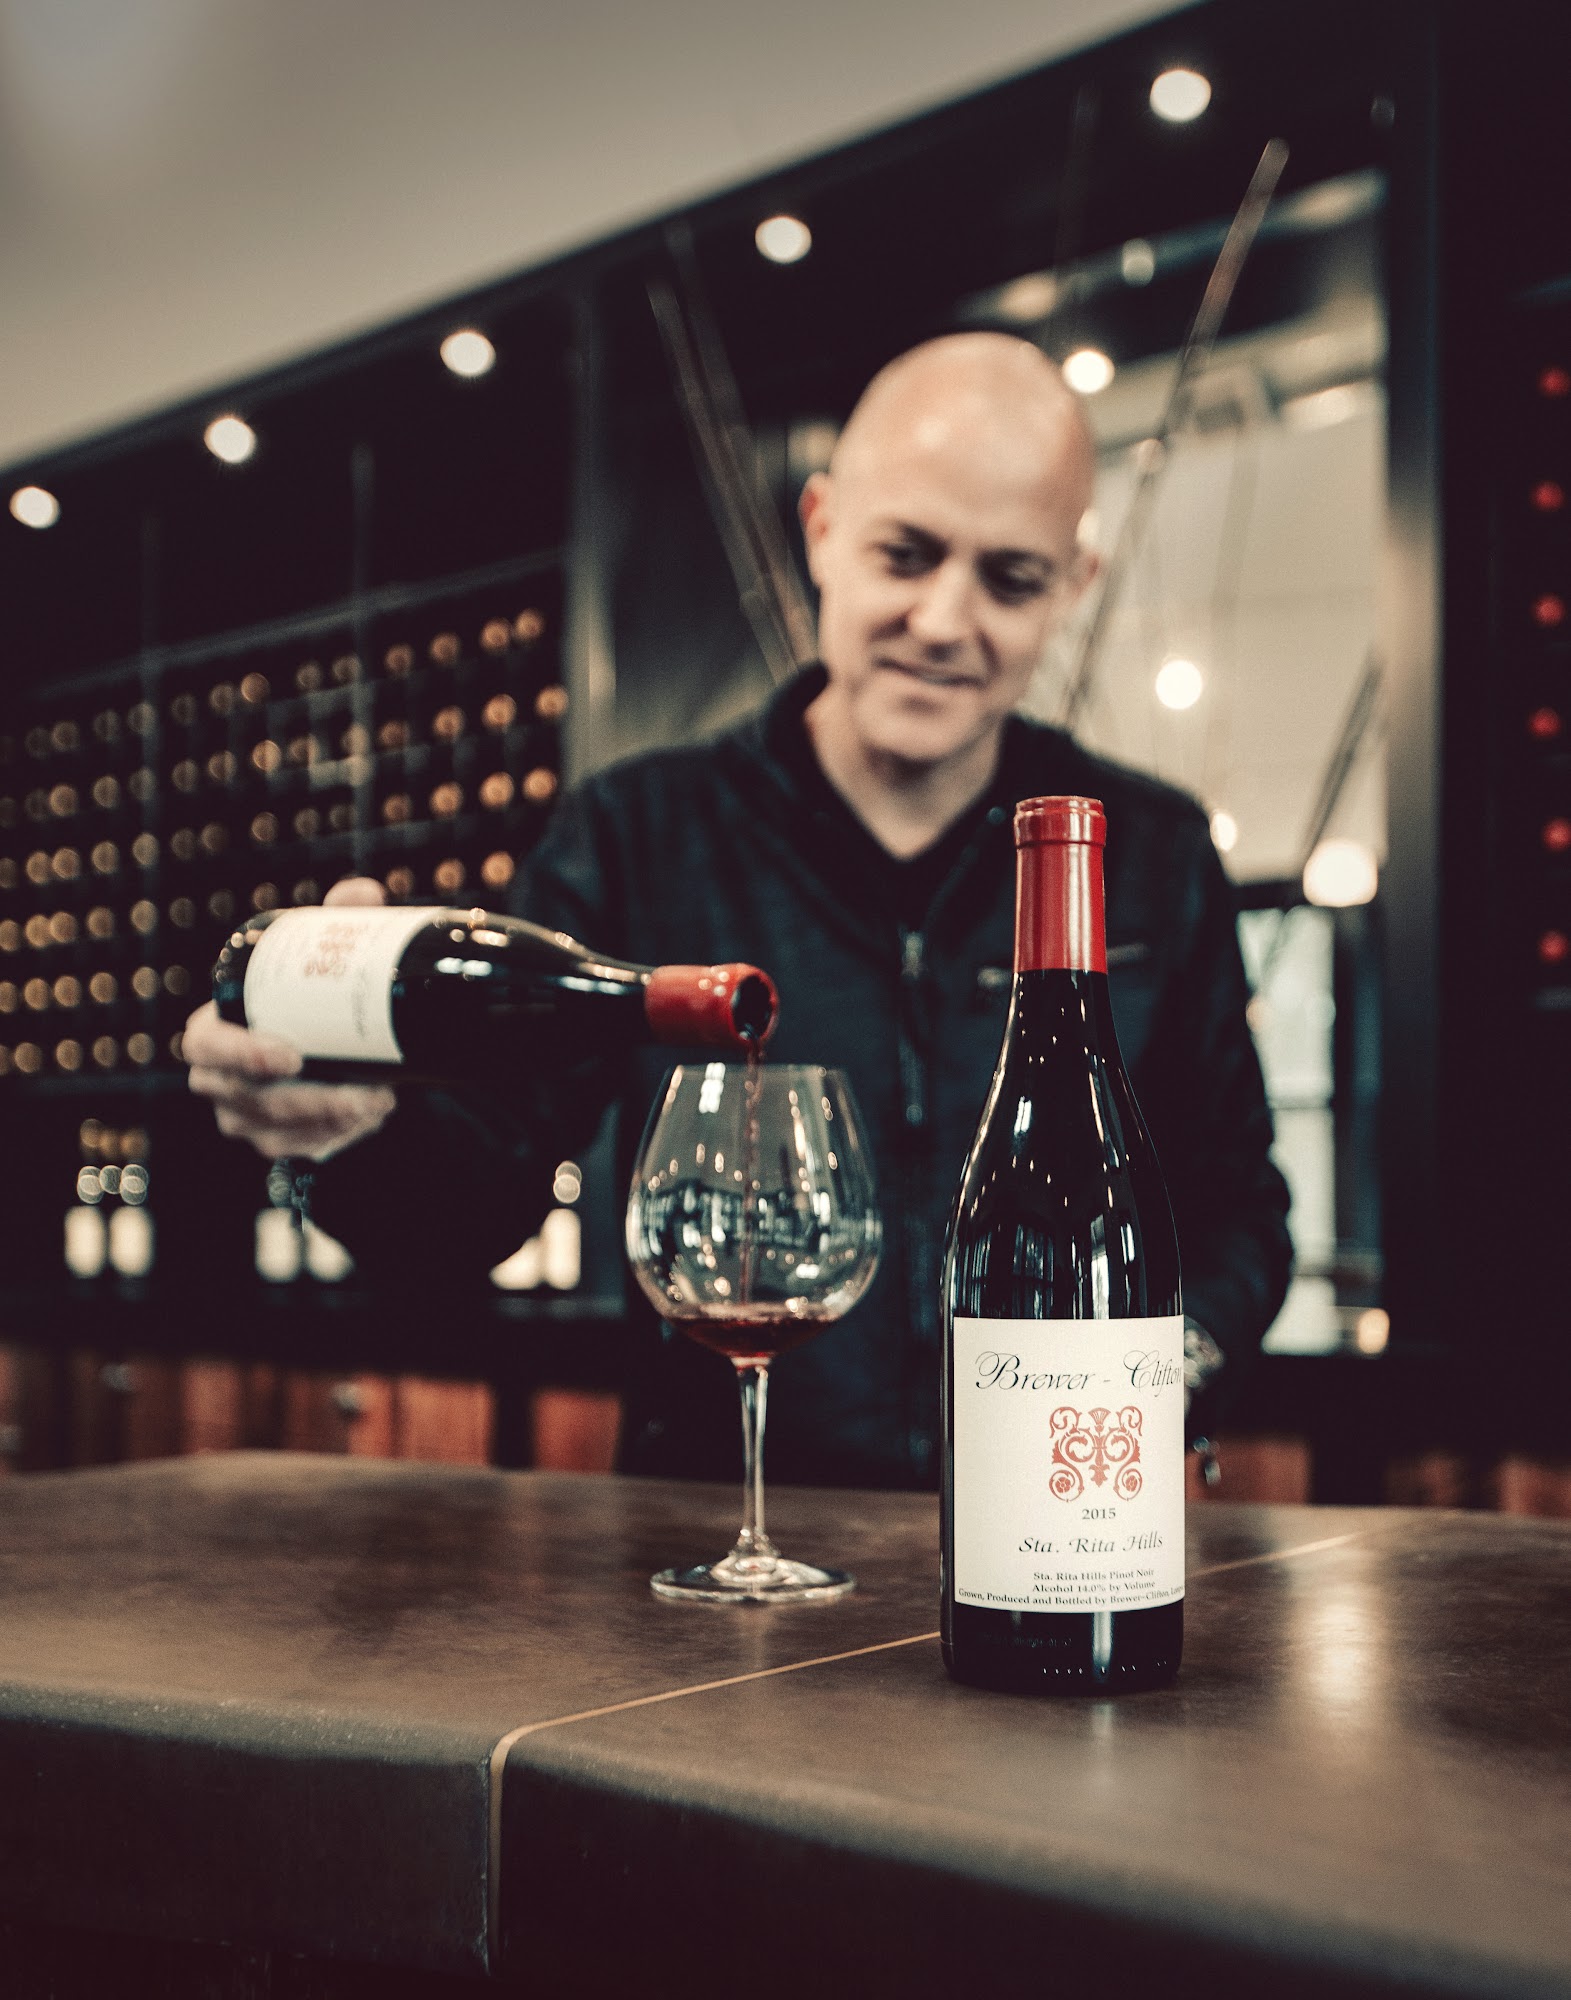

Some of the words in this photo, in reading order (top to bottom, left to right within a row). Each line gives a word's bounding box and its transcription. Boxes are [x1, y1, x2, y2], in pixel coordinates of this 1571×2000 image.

[975, 1350, 1095, 1390] Brewer
[1122, 1349, 1182, 1397] Clifton
[1082, 1507, 1116, 1520] 2015
[1018, 1536, 1059, 1553] Sta.
[1069, 1537, 1115, 1553] Rita
[1123, 1530, 1163, 1552] Hills
[1033, 1571, 1053, 1581] Sta.
[1056, 1572, 1078, 1581] Rita
[1081, 1571, 1107, 1581] Hills
[1110, 1570, 1134, 1579] Pinot
[1136, 1568, 1155, 1577] Noir
[1032, 1583, 1074, 1592] Alcohol
[1109, 1583, 1121, 1592] by
[1124, 1580, 1156, 1591] Volume
[958, 1588, 985, 1601] Grown,
[987, 1592, 1030, 1604] Produced
[1032, 1596, 1052, 1605] and
[1055, 1596, 1092, 1605] Bottled
[1094, 1596, 1107, 1605] by
